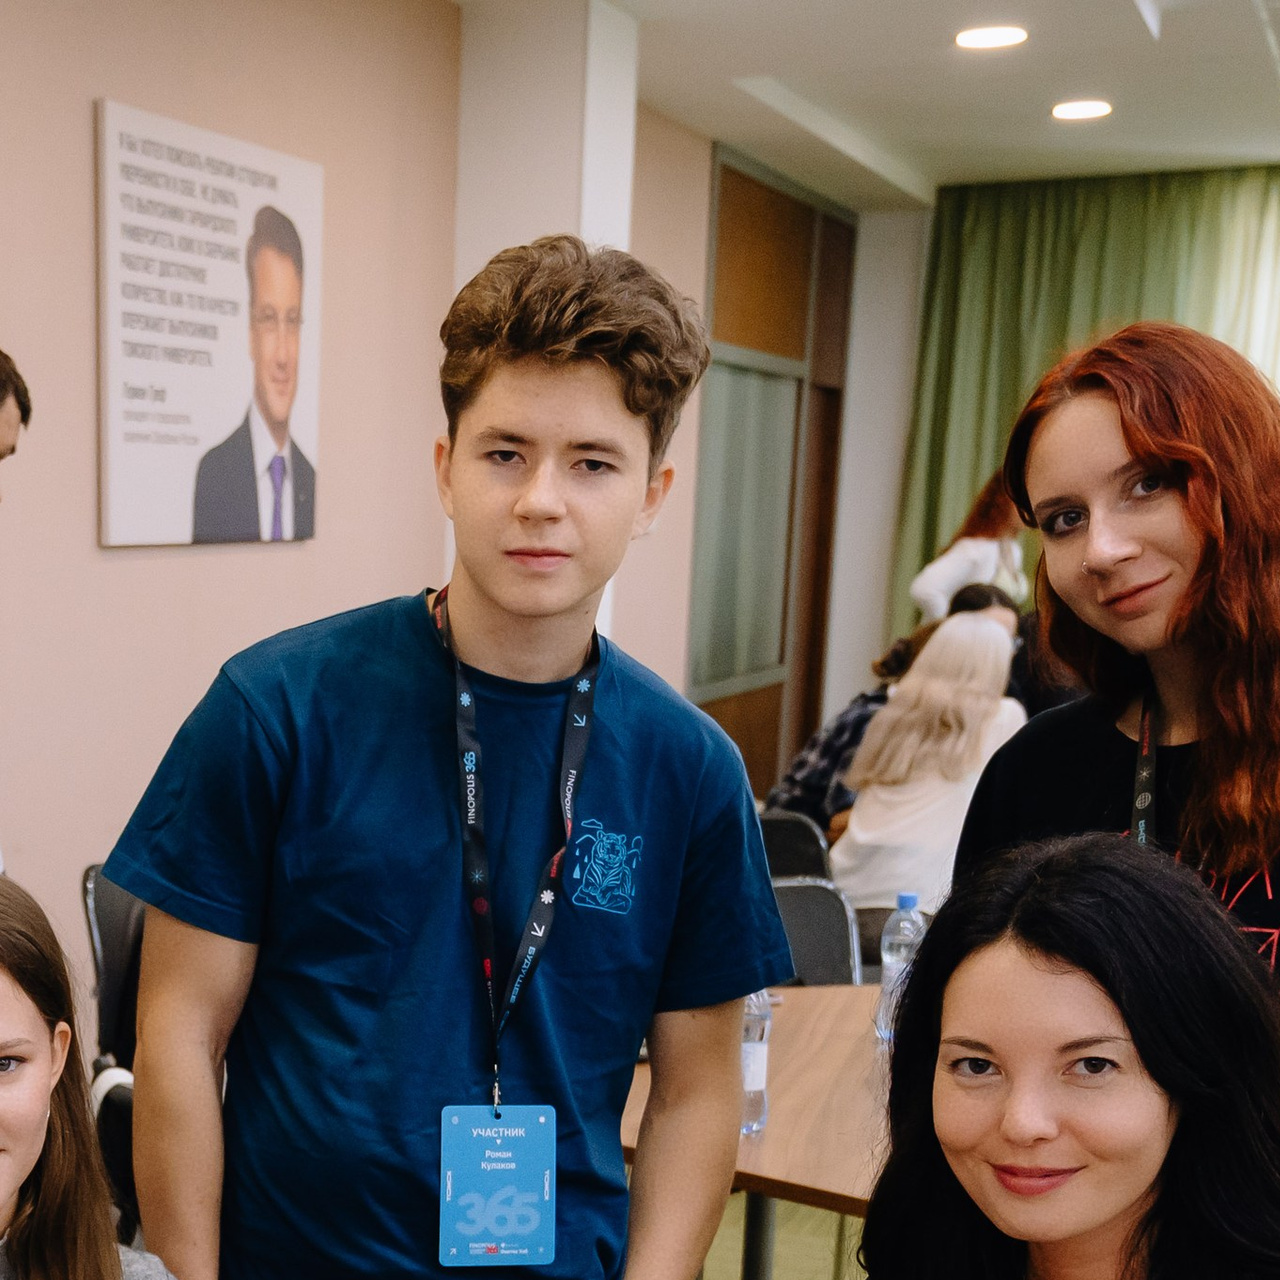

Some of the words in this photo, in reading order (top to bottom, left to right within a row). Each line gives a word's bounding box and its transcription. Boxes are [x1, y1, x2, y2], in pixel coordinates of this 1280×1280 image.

[463, 751, 476, 773] 365
[467, 774, 476, 825] FINOPOLIS
[471, 1127, 526, 1138] УЧАСТНИК
[485, 1150, 512, 1159] Роман
[481, 1161, 516, 1171] Кулаков
[455, 1185, 541, 1237] 365
